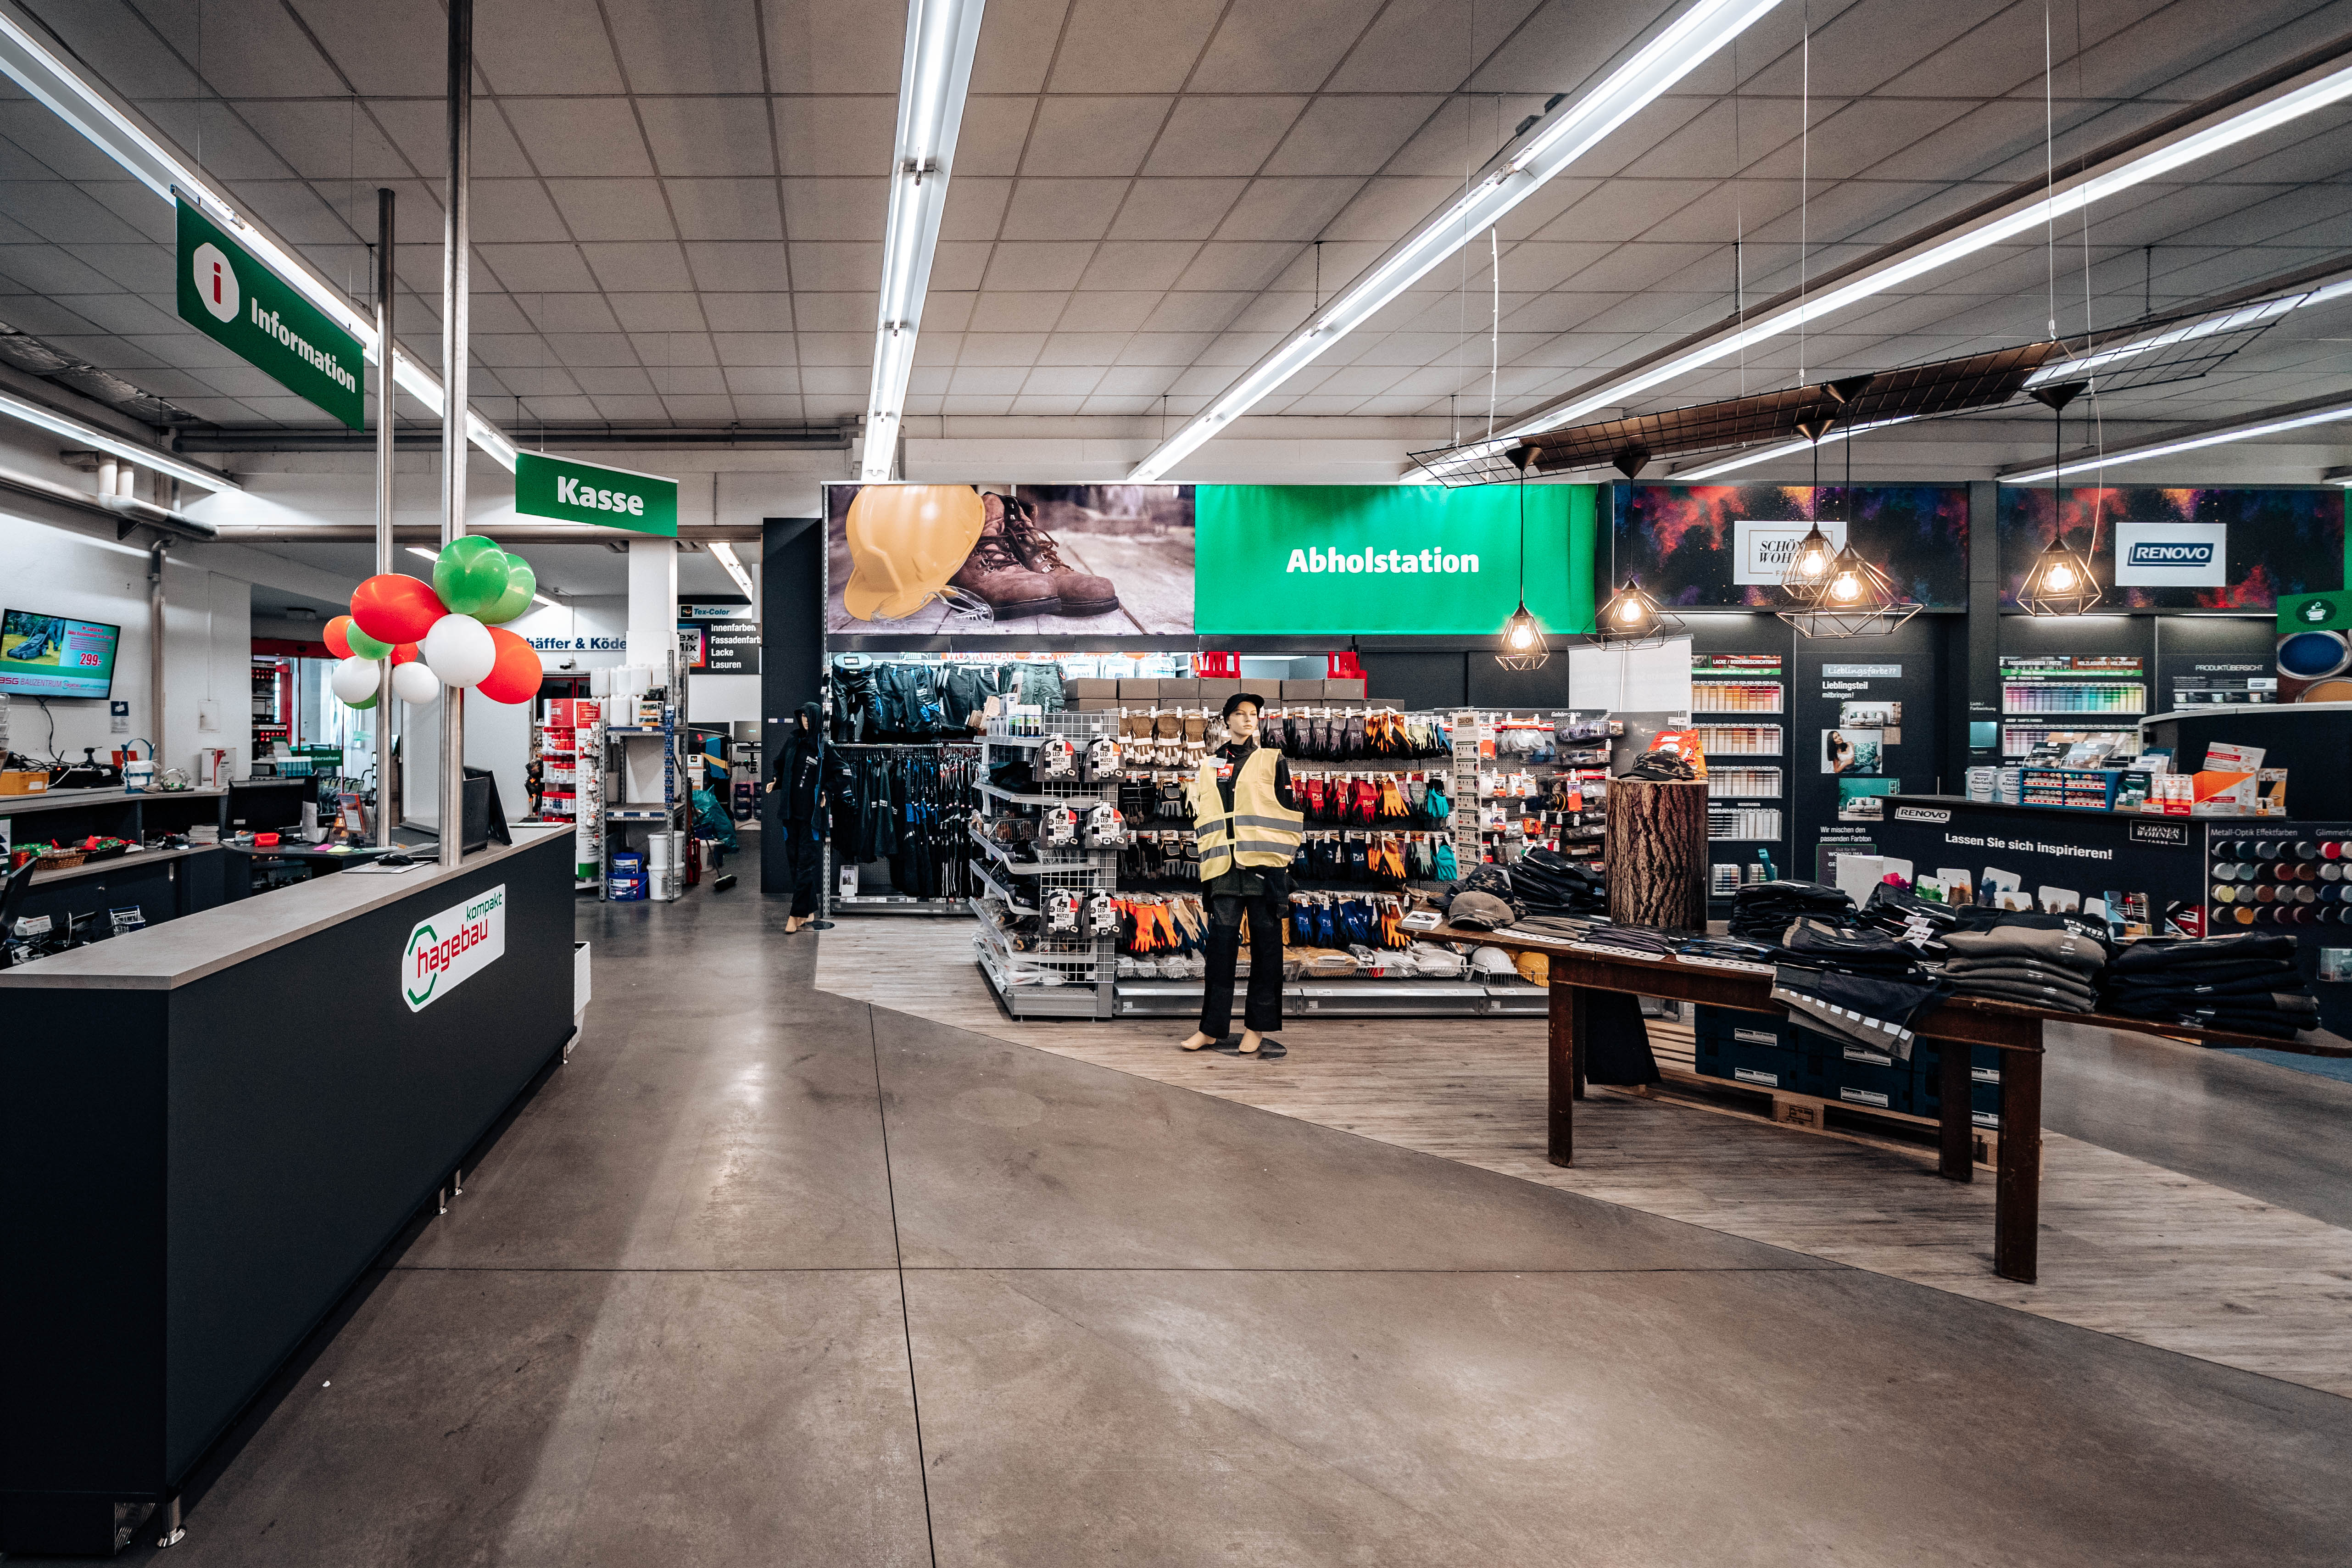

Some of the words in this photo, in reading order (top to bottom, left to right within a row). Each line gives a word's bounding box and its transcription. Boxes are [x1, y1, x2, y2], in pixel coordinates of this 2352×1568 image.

[251, 297, 355, 393] Information
[558, 476, 643, 516] Kasse
[2136, 547, 2210, 559] RENOVO
[1286, 547, 1479, 573] Abholstation
[711, 624, 756, 632] Innenfarben
[575, 638, 585, 649] &
[711, 660, 741, 669] Lasuren
[1828, 666, 1896, 676] Lieblingsfarbe??
[21, 678, 62, 687] BAUZENTRUM
[1822, 681, 1868, 691] Lieblingsteil
[1901, 809, 1948, 819] RENOVO
[2137, 831, 2179, 839] WOHNEN
[1945, 833, 1984, 846] Lassen
[1987, 837, 2005, 848] Sie
[2008, 840, 2034, 852] sich
[2037, 843, 2112, 860] inspirieren!
[466, 892, 502, 922] kompakt
[418, 919, 488, 979] hagebau
